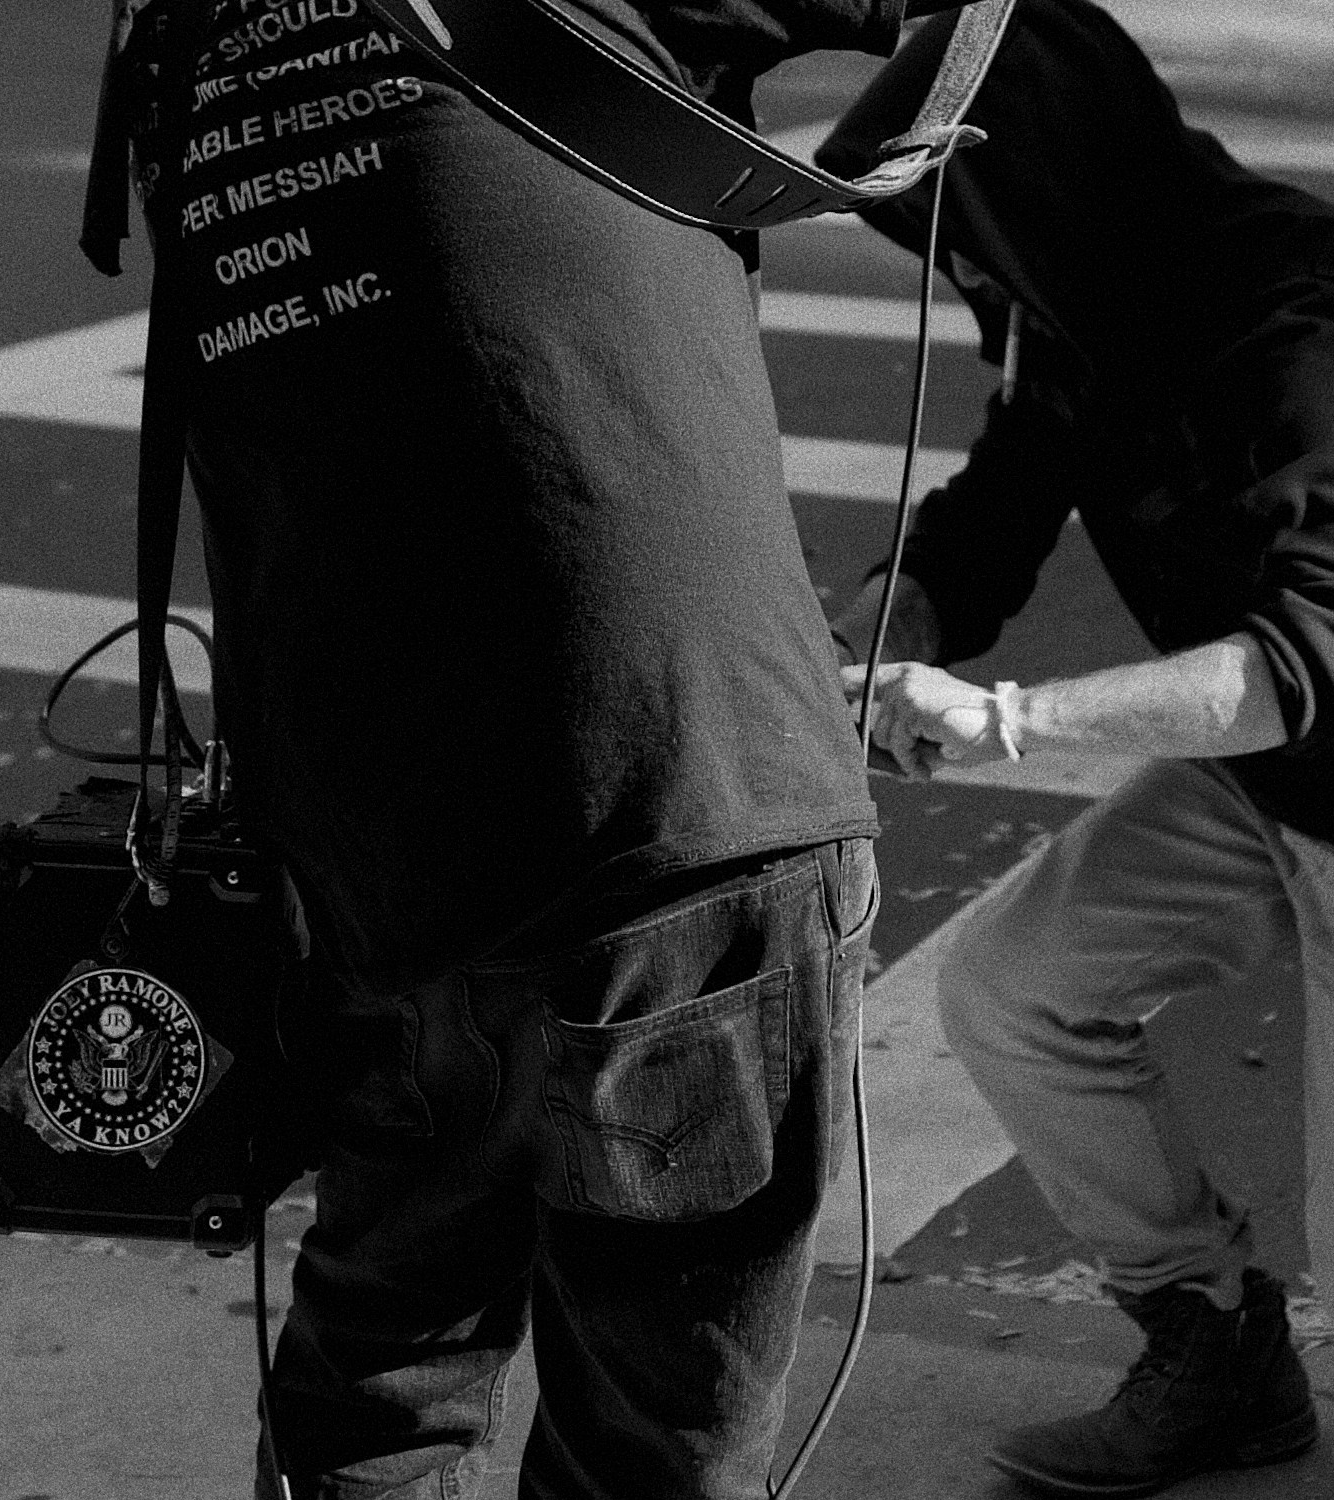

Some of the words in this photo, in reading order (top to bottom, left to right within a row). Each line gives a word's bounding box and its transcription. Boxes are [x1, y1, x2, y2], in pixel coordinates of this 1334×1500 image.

[183, 116, 265, 173] ABLE
[273, 76, 424, 139] HEROES
[226, 141, 383, 215] MESSIAH
[214, 226, 312, 285] ORION
[198, 295, 321, 363] DAMAGE,
[322, 271, 392, 316] INC.
[43, 979, 91, 1033] JOEY
[97, 974, 192, 1035] RAMONE
[103, 1012, 127, 1028] JR
[93, 1098, 184, 1146] KNOW?
